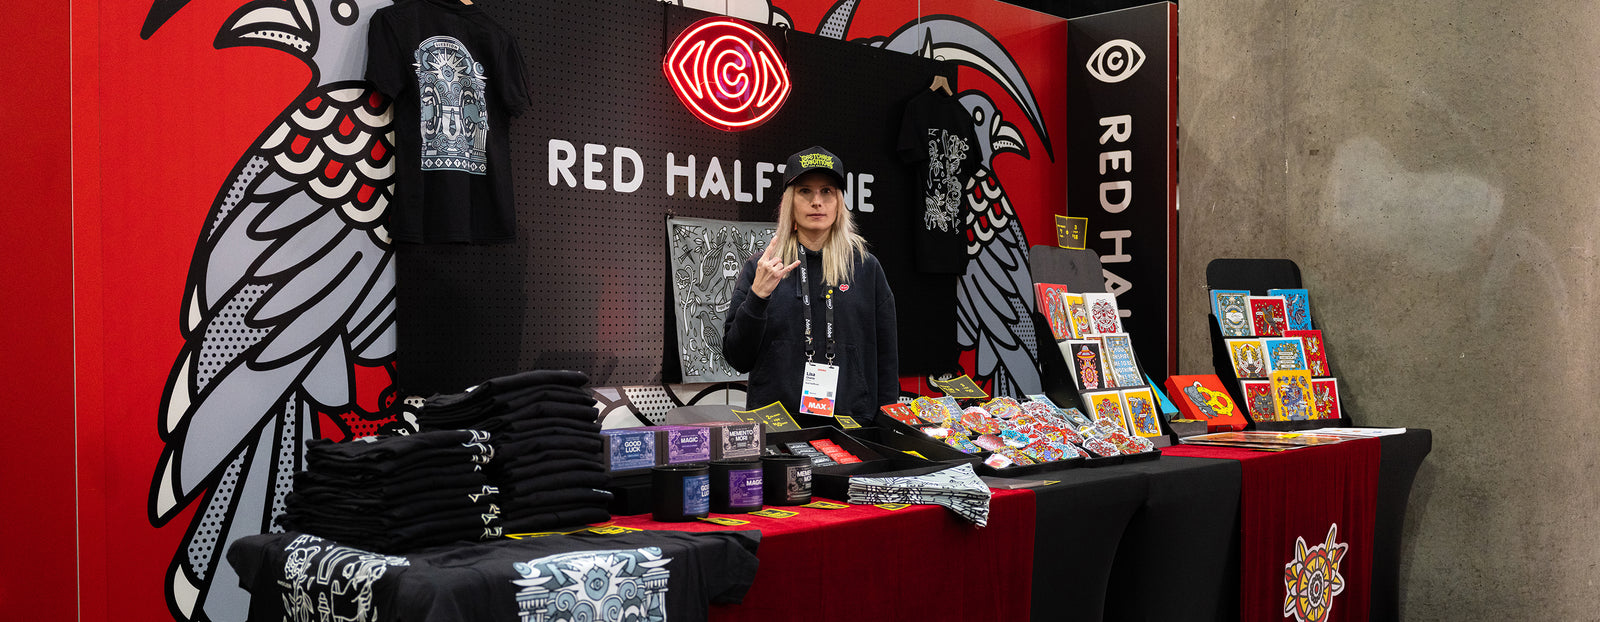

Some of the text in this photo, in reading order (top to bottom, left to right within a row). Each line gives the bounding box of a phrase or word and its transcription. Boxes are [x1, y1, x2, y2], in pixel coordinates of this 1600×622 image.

[548, 138, 874, 212] RED HALFNE
[1099, 114, 1132, 318] RED HA
[808, 402, 826, 410] MAX
